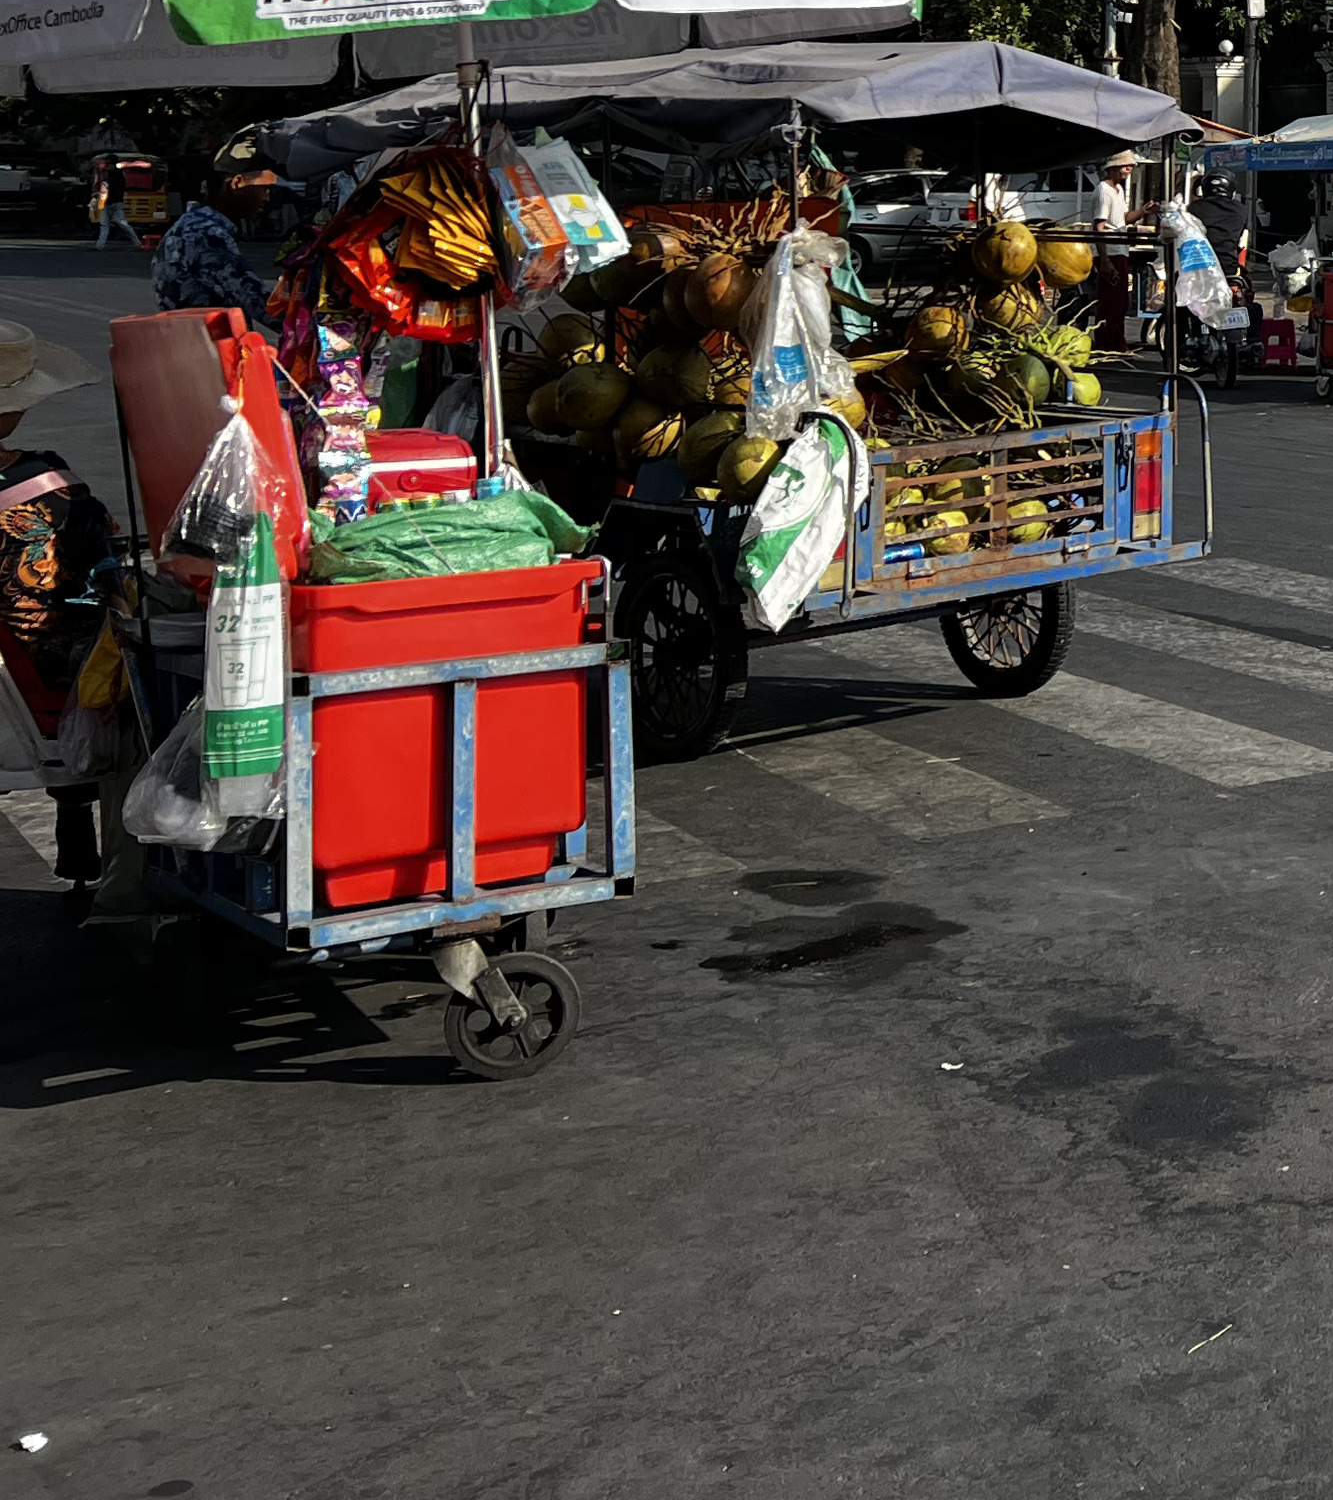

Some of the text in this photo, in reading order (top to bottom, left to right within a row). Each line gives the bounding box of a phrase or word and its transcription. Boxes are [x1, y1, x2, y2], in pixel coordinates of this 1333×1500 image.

[45, 1, 104, 29] Cambodia
[288, 16, 307, 26] THE
[310, 14, 345, 24] FINEST
[345, 10, 388, 22] QUALITY
[389, 8, 415, 17] PENS
[426, 3, 485, 15] STATIONERY
[215, 614, 242, 633] 32
[227, 662, 245, 674] 32
